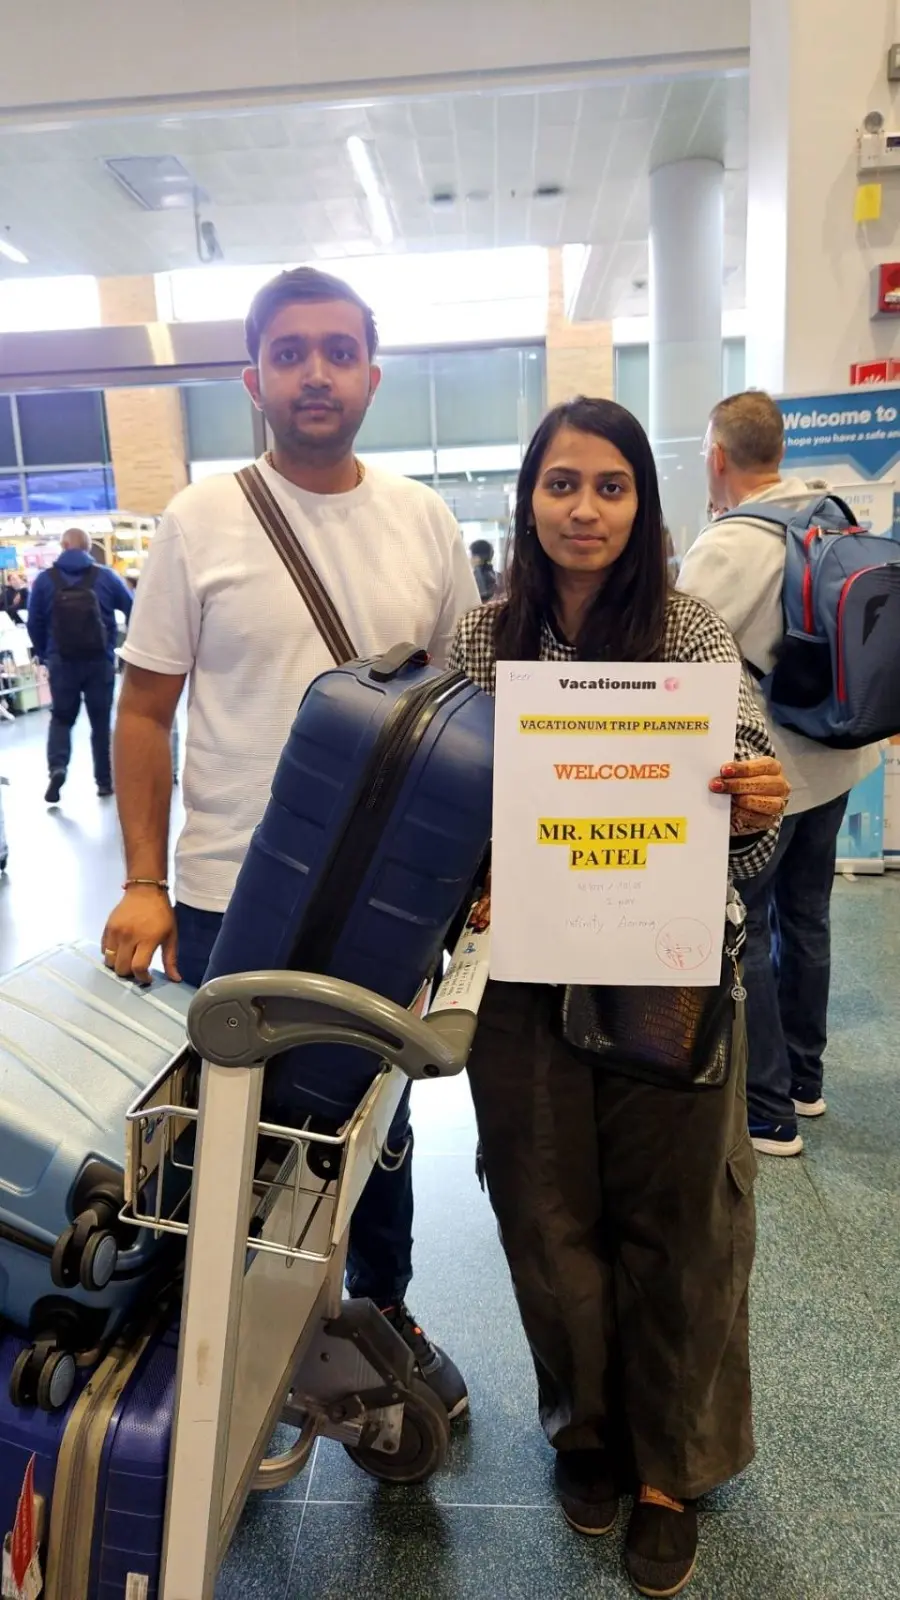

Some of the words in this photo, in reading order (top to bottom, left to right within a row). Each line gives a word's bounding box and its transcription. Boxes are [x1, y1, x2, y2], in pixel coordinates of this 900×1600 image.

[782, 410, 872, 430] Welcome
[875, 405, 897, 422] to
[787, 437, 812, 447] hope
[813, 435, 832, 446] you
[833, 433, 857, 443] have
[857, 432, 864, 440] a
[865, 429, 886, 440] safe
[887, 430, 900, 439] an
[559, 678, 657, 690] Vacationum
[520, 720, 607, 731] VACATIONUM
[611, 720, 640, 731] TRIP
[643, 720, 710, 731] PLANNERS
[553, 763, 670, 780] WELCOMES
[538, 823, 583, 840] MR.
[590, 822, 680, 840] KISHAN
[571, 848, 647, 866] PATEL
